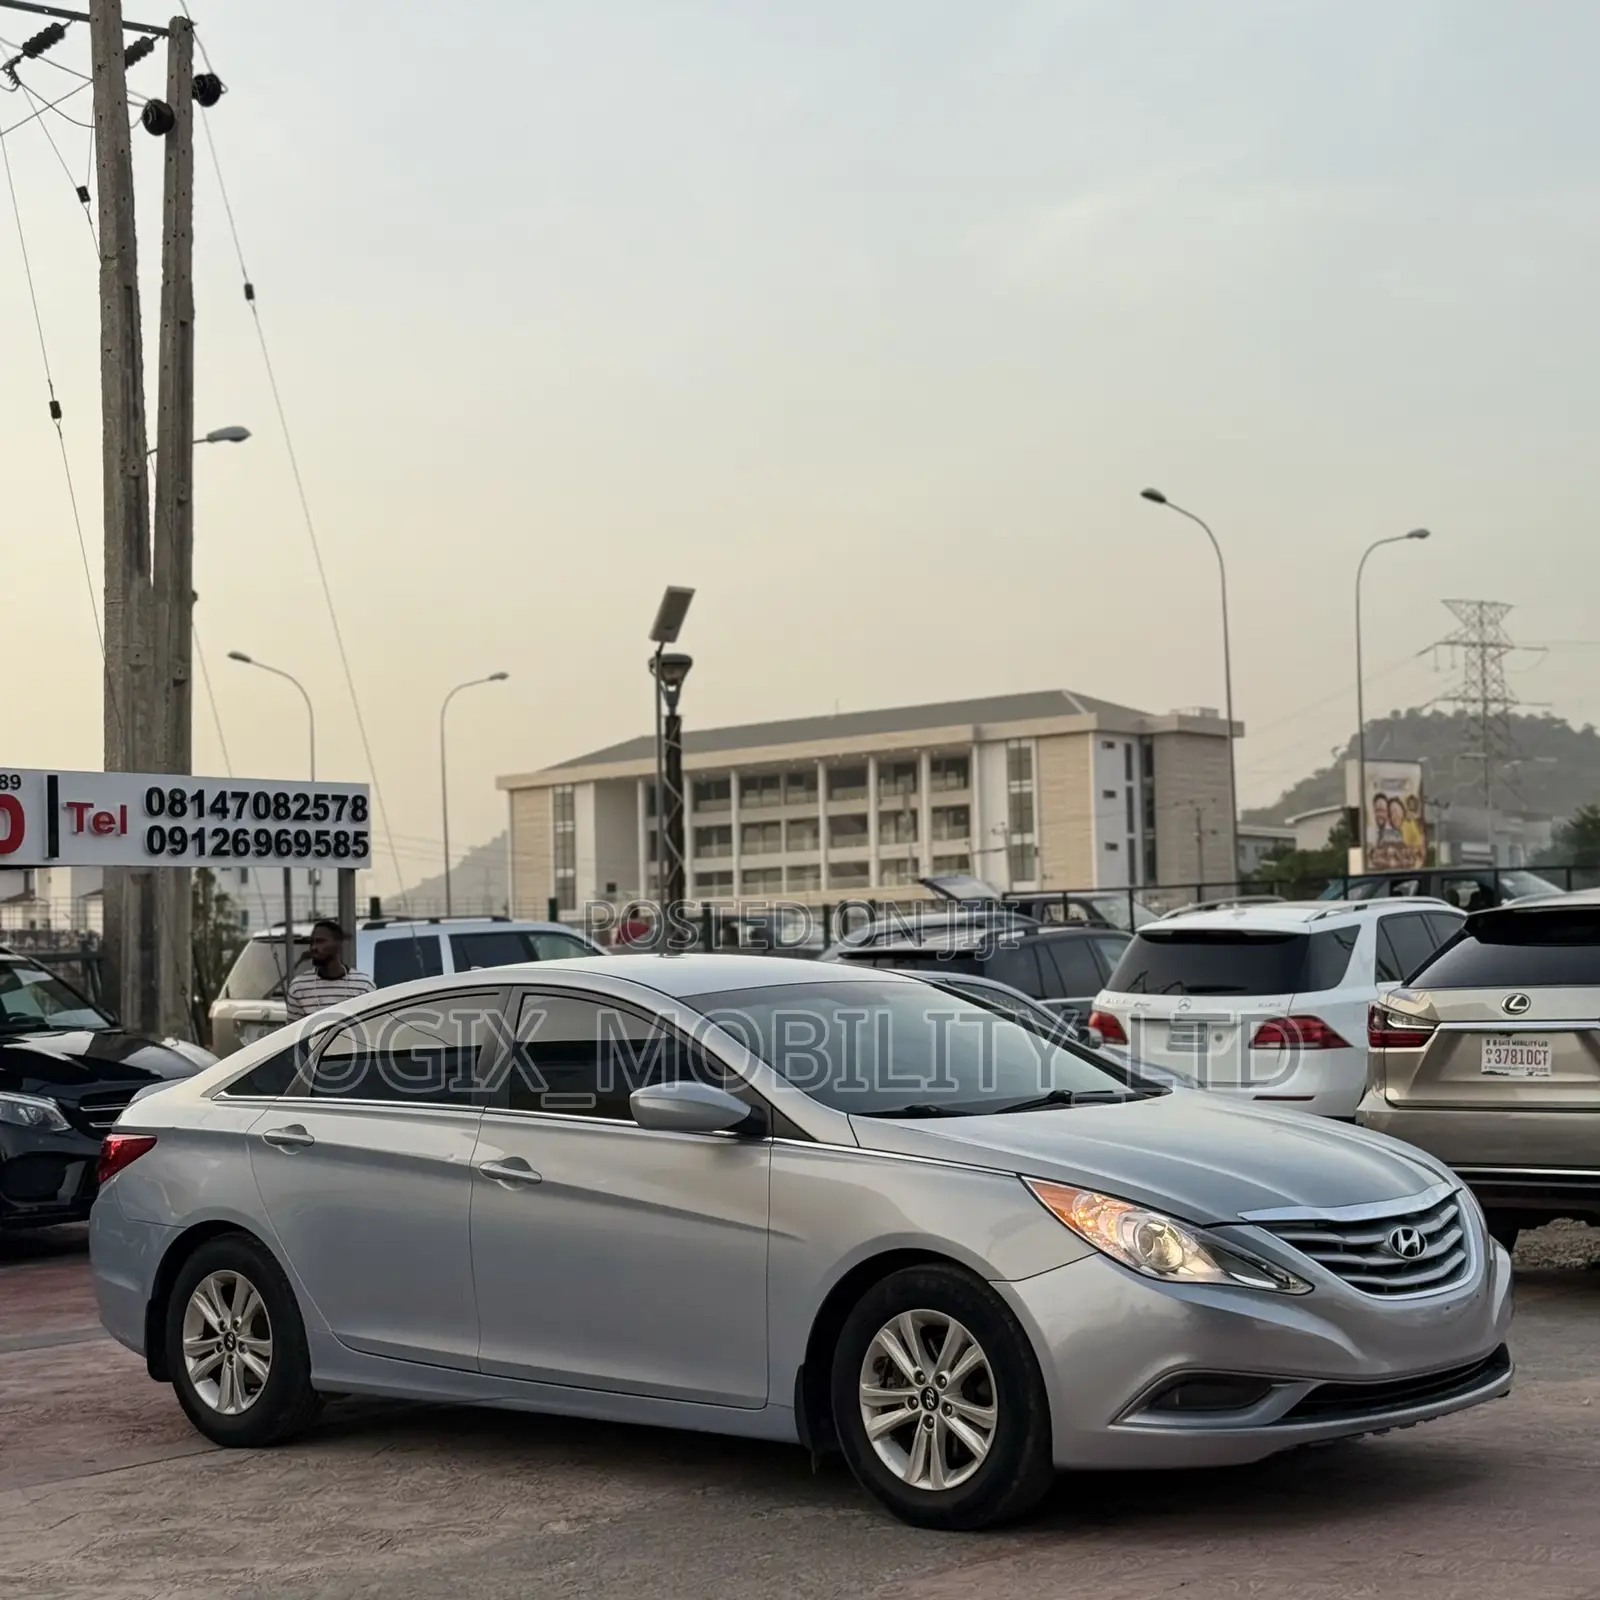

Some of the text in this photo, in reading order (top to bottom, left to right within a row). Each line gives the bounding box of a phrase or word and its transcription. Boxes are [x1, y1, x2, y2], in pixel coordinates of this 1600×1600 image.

[65, 801, 128, 835] Tel
[146, 786, 368, 822] 08147082578
[146, 824, 369, 859] 09126969585
